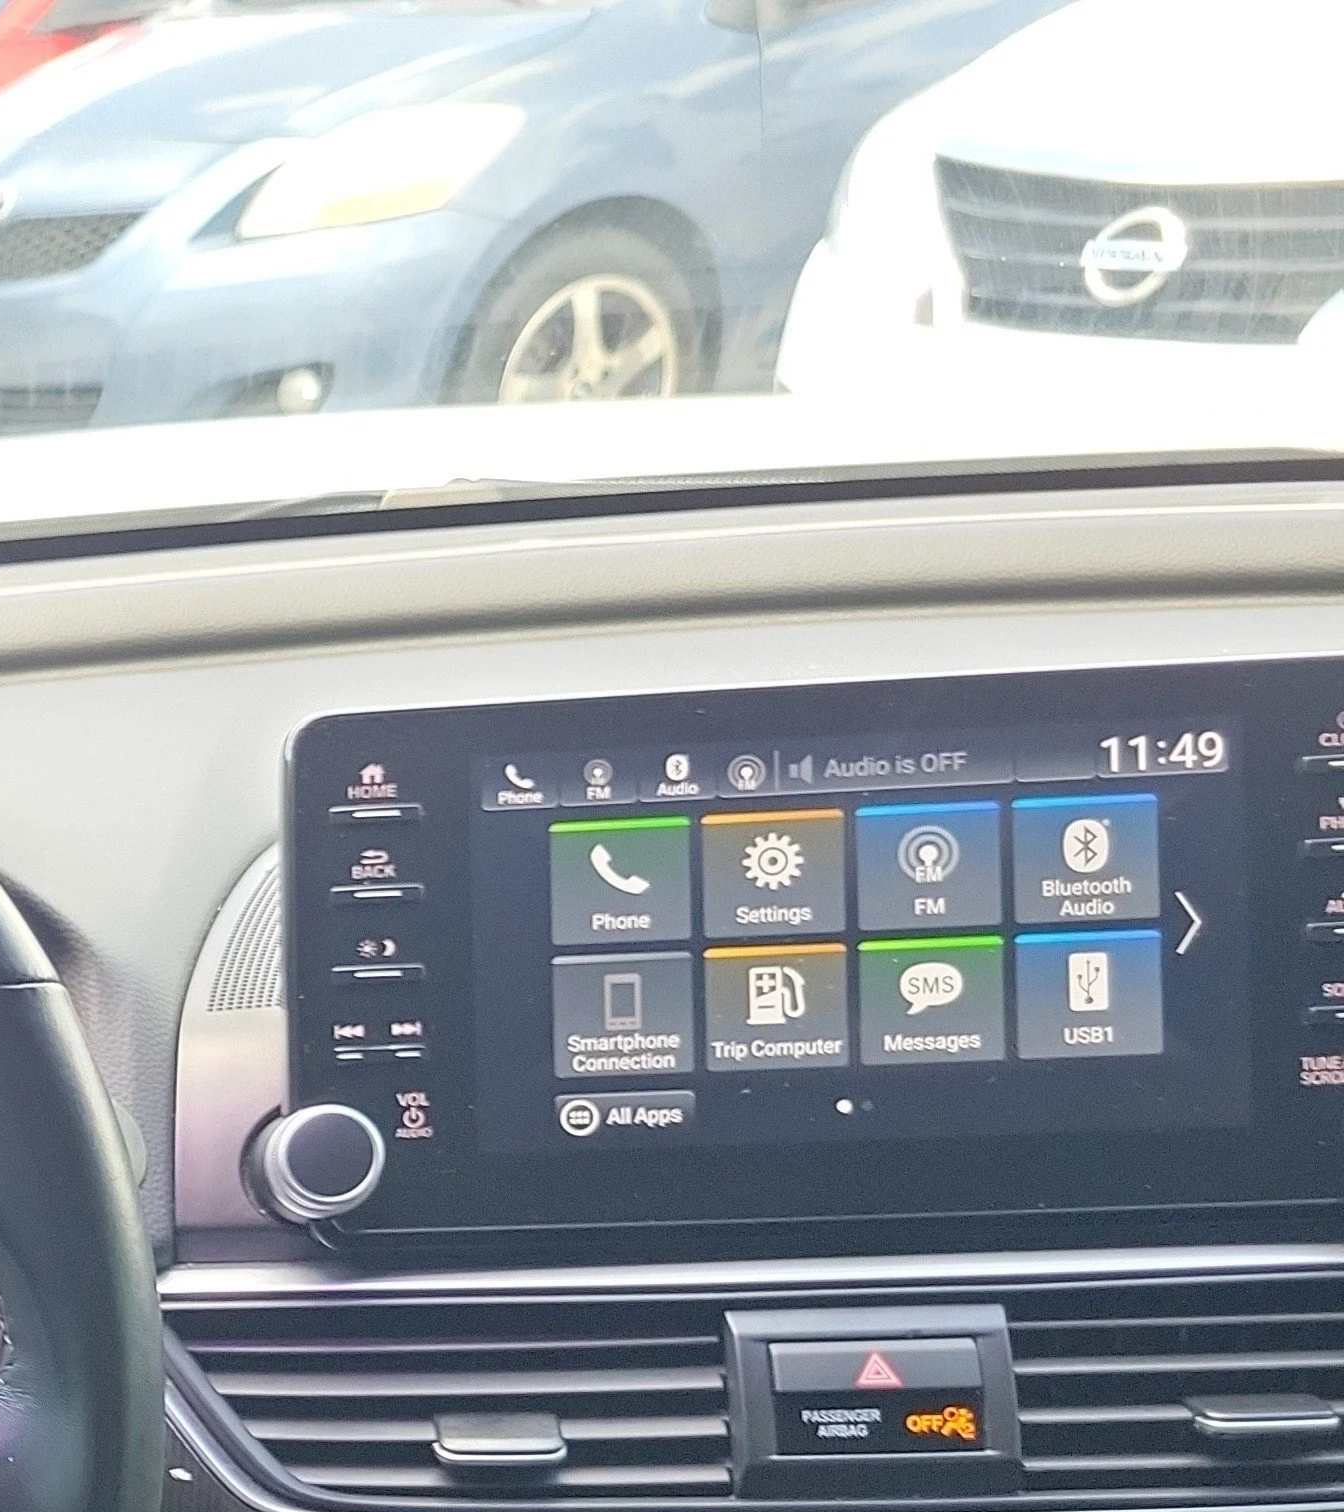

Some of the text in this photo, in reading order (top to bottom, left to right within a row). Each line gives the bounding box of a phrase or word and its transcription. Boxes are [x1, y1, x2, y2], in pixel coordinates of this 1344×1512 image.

[1101, 731, 1225, 773] 11:49
[824, 752, 968, 778] Audio is OFF
[347, 783, 397, 799] HOME
[498, 791, 543, 805] Phone
[586, 787, 611, 800] FM
[656, 783, 700, 797] Audio
[351, 864, 396, 880] BACK
[914, 866, 943, 883] FM
[1041, 877, 1132, 898] Bluetooth
[735, 905, 813, 926] Settings
[914, 899, 946, 915] FM
[1059, 899, 1115, 917] Audio
[590, 912, 651, 931] Phone
[907, 975, 955, 994] SMS
[566, 1033, 681, 1053] Smartphone
[883, 1034, 982, 1052] Messages
[1063, 1026, 1113, 1045] USB1
[711, 1039, 843, 1061] Trip Computer
[572, 1052, 676, 1073] Connection
[395, 1092, 430, 1107] VOL
[606, 1107, 684, 1127] All Apps
[801, 1408, 883, 1424] PASSENGER
[906, 1414, 944, 1433] OFF
[816, 1423, 869, 1438] AIRBAG
